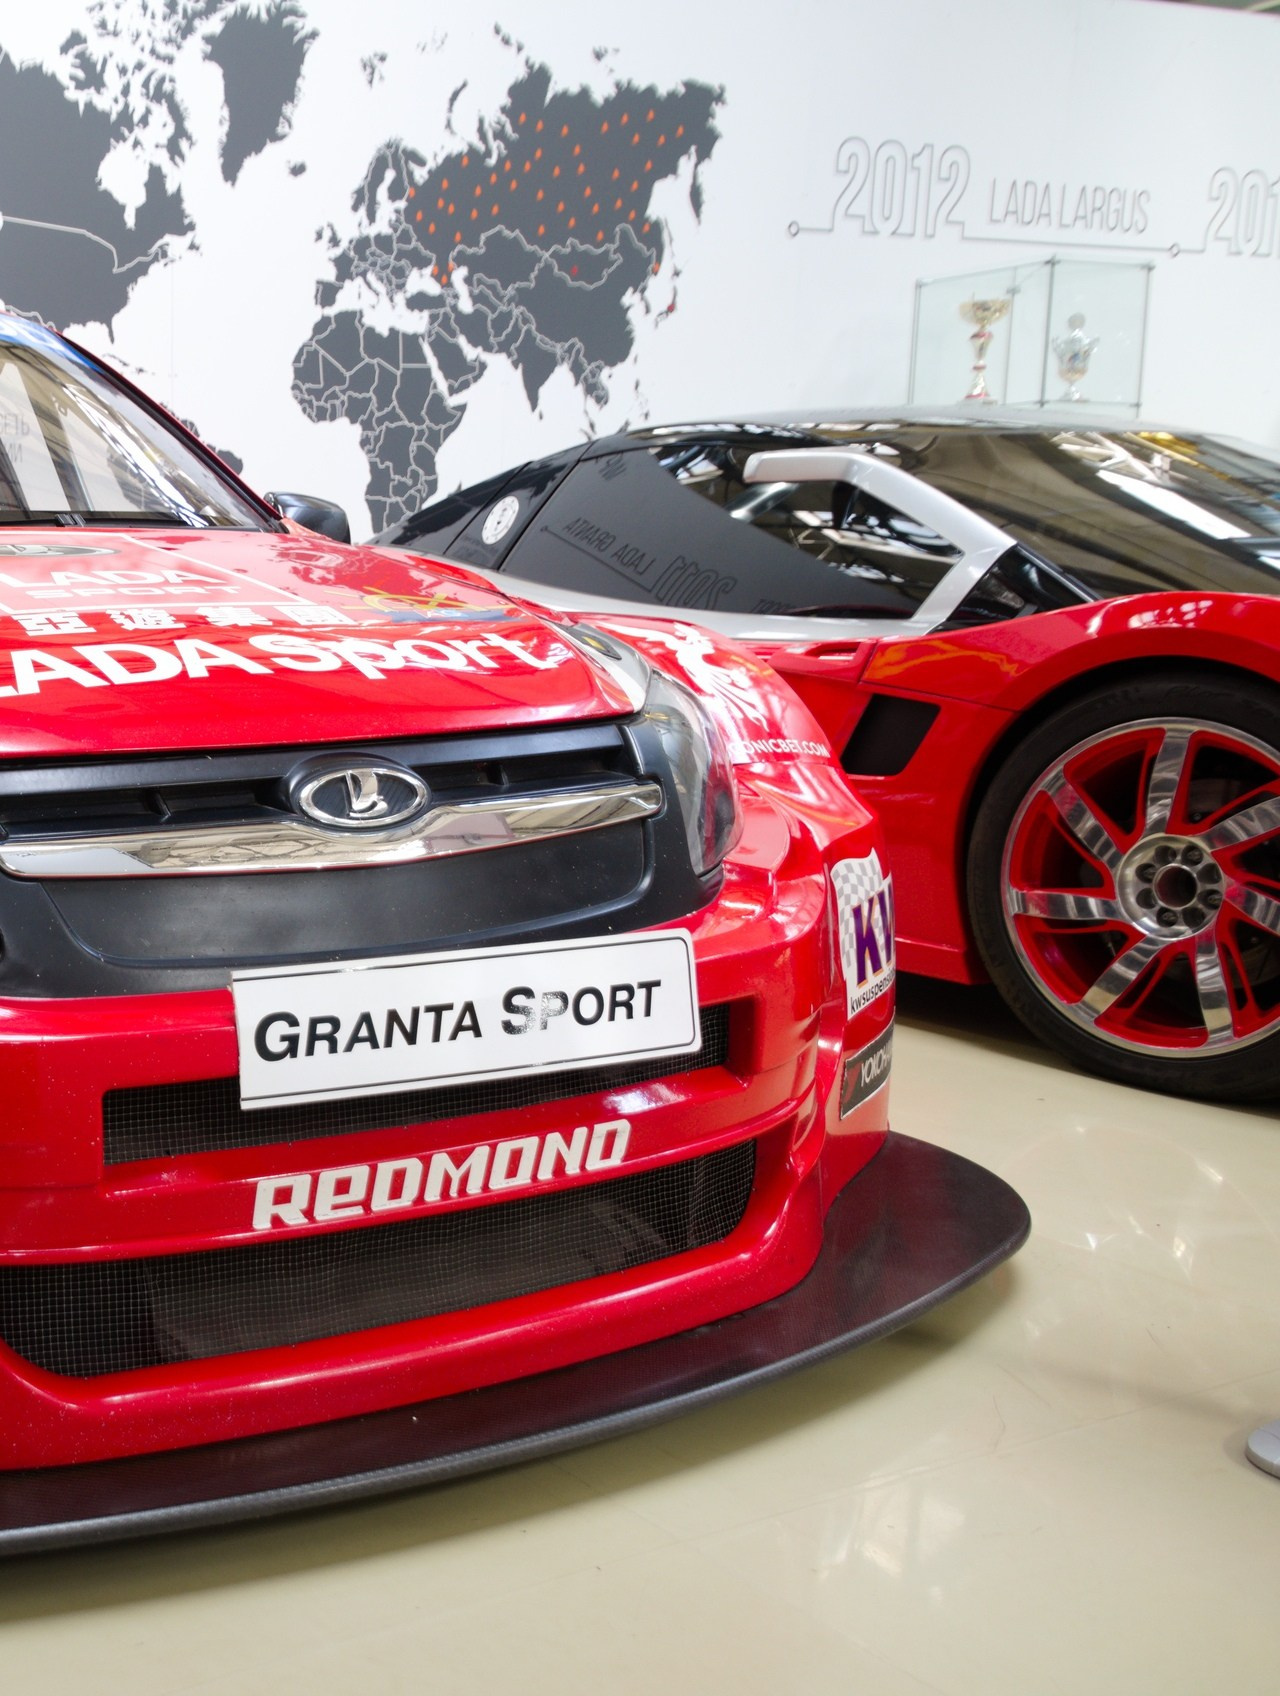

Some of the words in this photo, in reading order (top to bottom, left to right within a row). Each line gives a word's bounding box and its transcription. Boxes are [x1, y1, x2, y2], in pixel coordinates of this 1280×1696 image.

[832, 136, 971, 239] 2012
[989, 177, 1052, 227] LADA
[1059, 183, 1151, 234] LARGUS
[25, 585, 241, 599] SPORT
[253, 1000, 483, 1062] GRANTA
[501, 979, 662, 1036] SPORT
